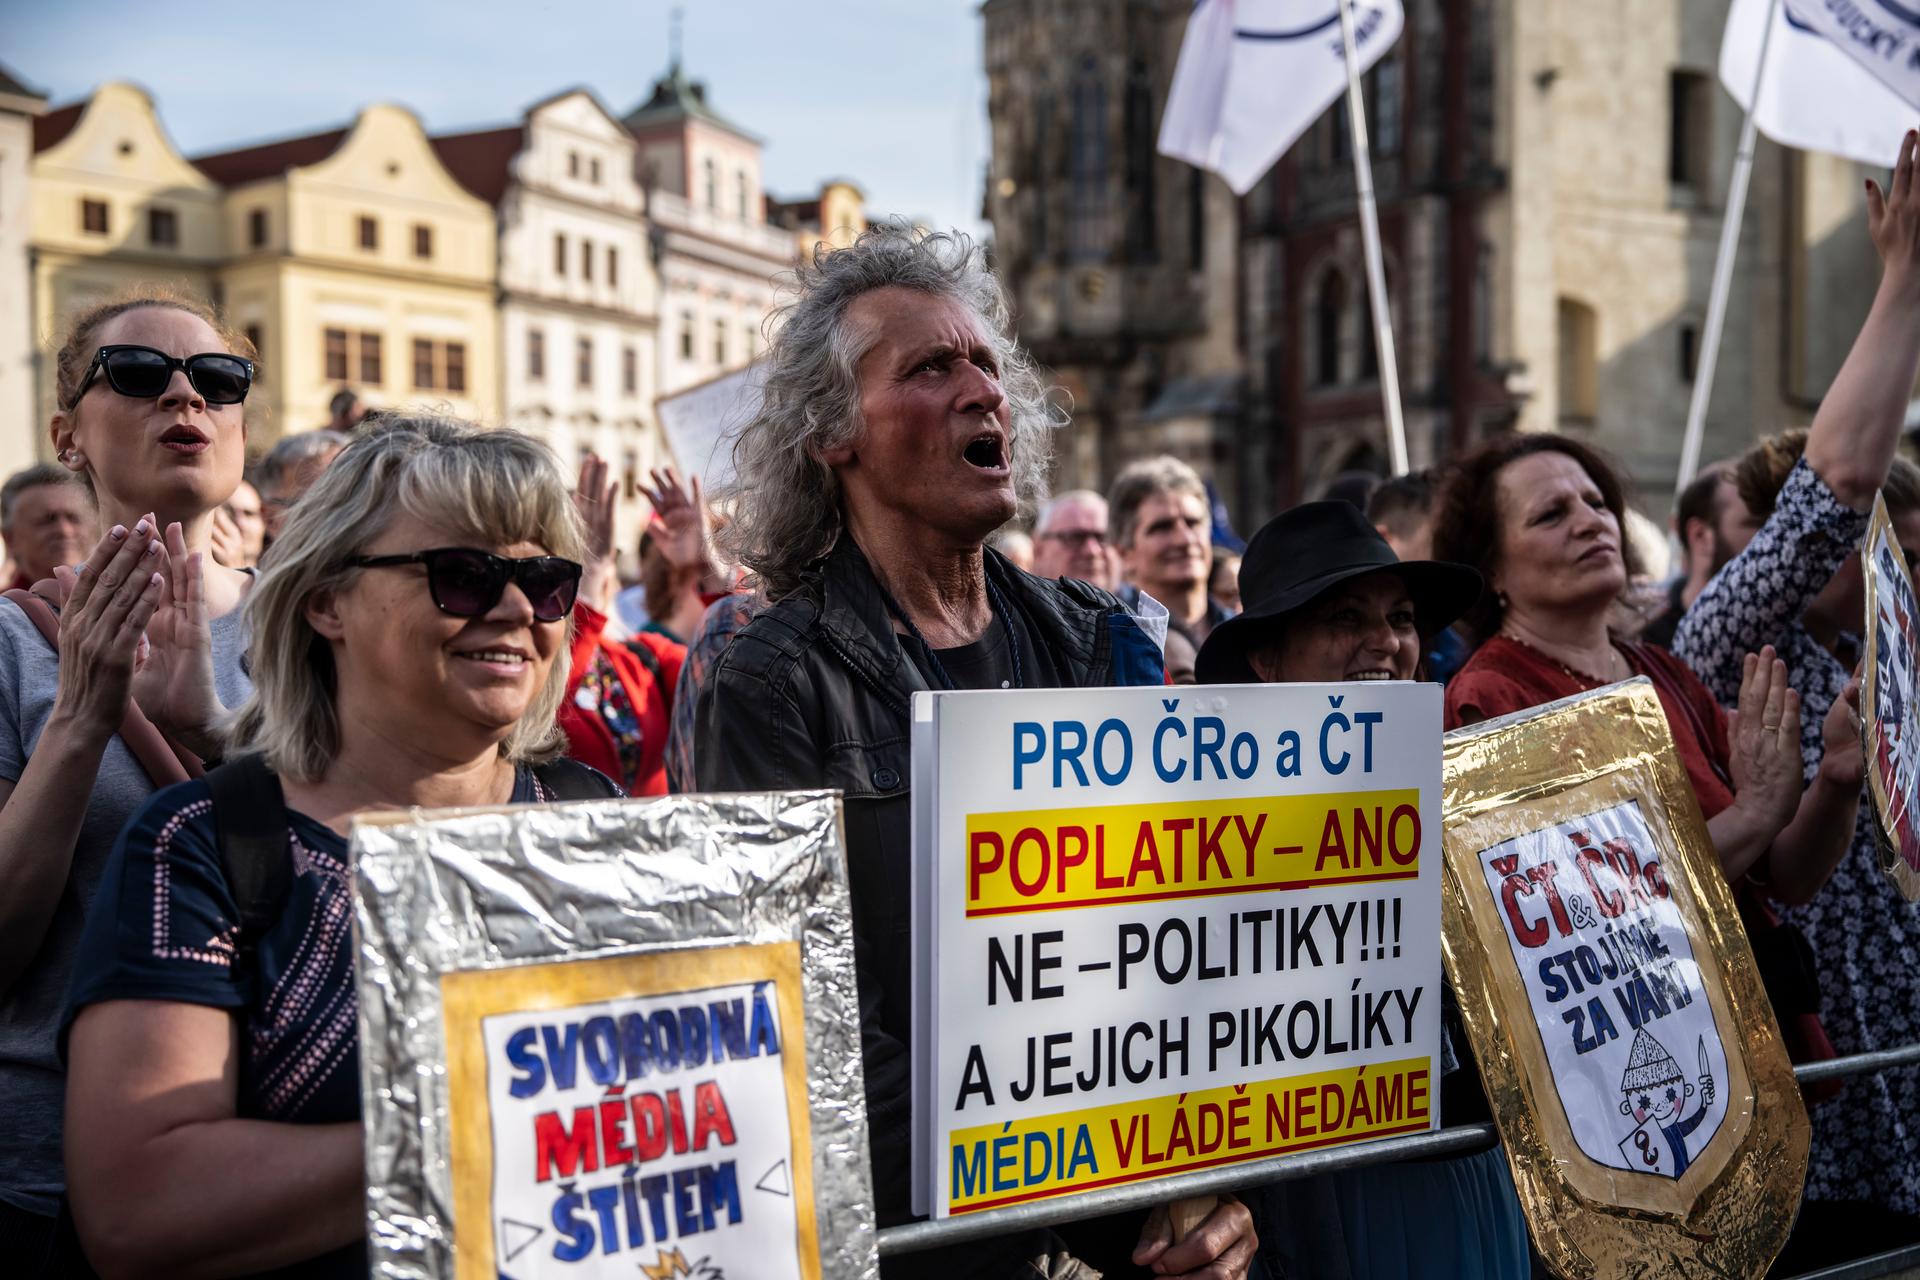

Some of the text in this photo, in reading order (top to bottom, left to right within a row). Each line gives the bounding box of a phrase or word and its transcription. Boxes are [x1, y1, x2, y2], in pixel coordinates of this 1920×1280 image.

[1013, 695, 1383, 790] PRO ČRo a ČT
[970, 812, 1268, 901] POPLATKY
[1315, 803, 1422, 872] ANO
[1489, 854, 1574, 948] ČT
[1569, 895, 1597, 930] &
[987, 930, 1064, 1006] NE
[1538, 917, 1670, 1003] STOJÍME
[1561, 961, 1693, 1055] ZA VÁMI
[505, 981, 781, 1100] SVOBODNÁ
[954, 978, 1423, 1111] A JEJICH PIKOLÍKY
[533, 1080, 737, 1183] MÉDIA
[952, 1066, 1429, 1200] MÉDIA VLÁDĚ NEDÁME
[552, 1159, 742, 1263] ŠTÍTEM
